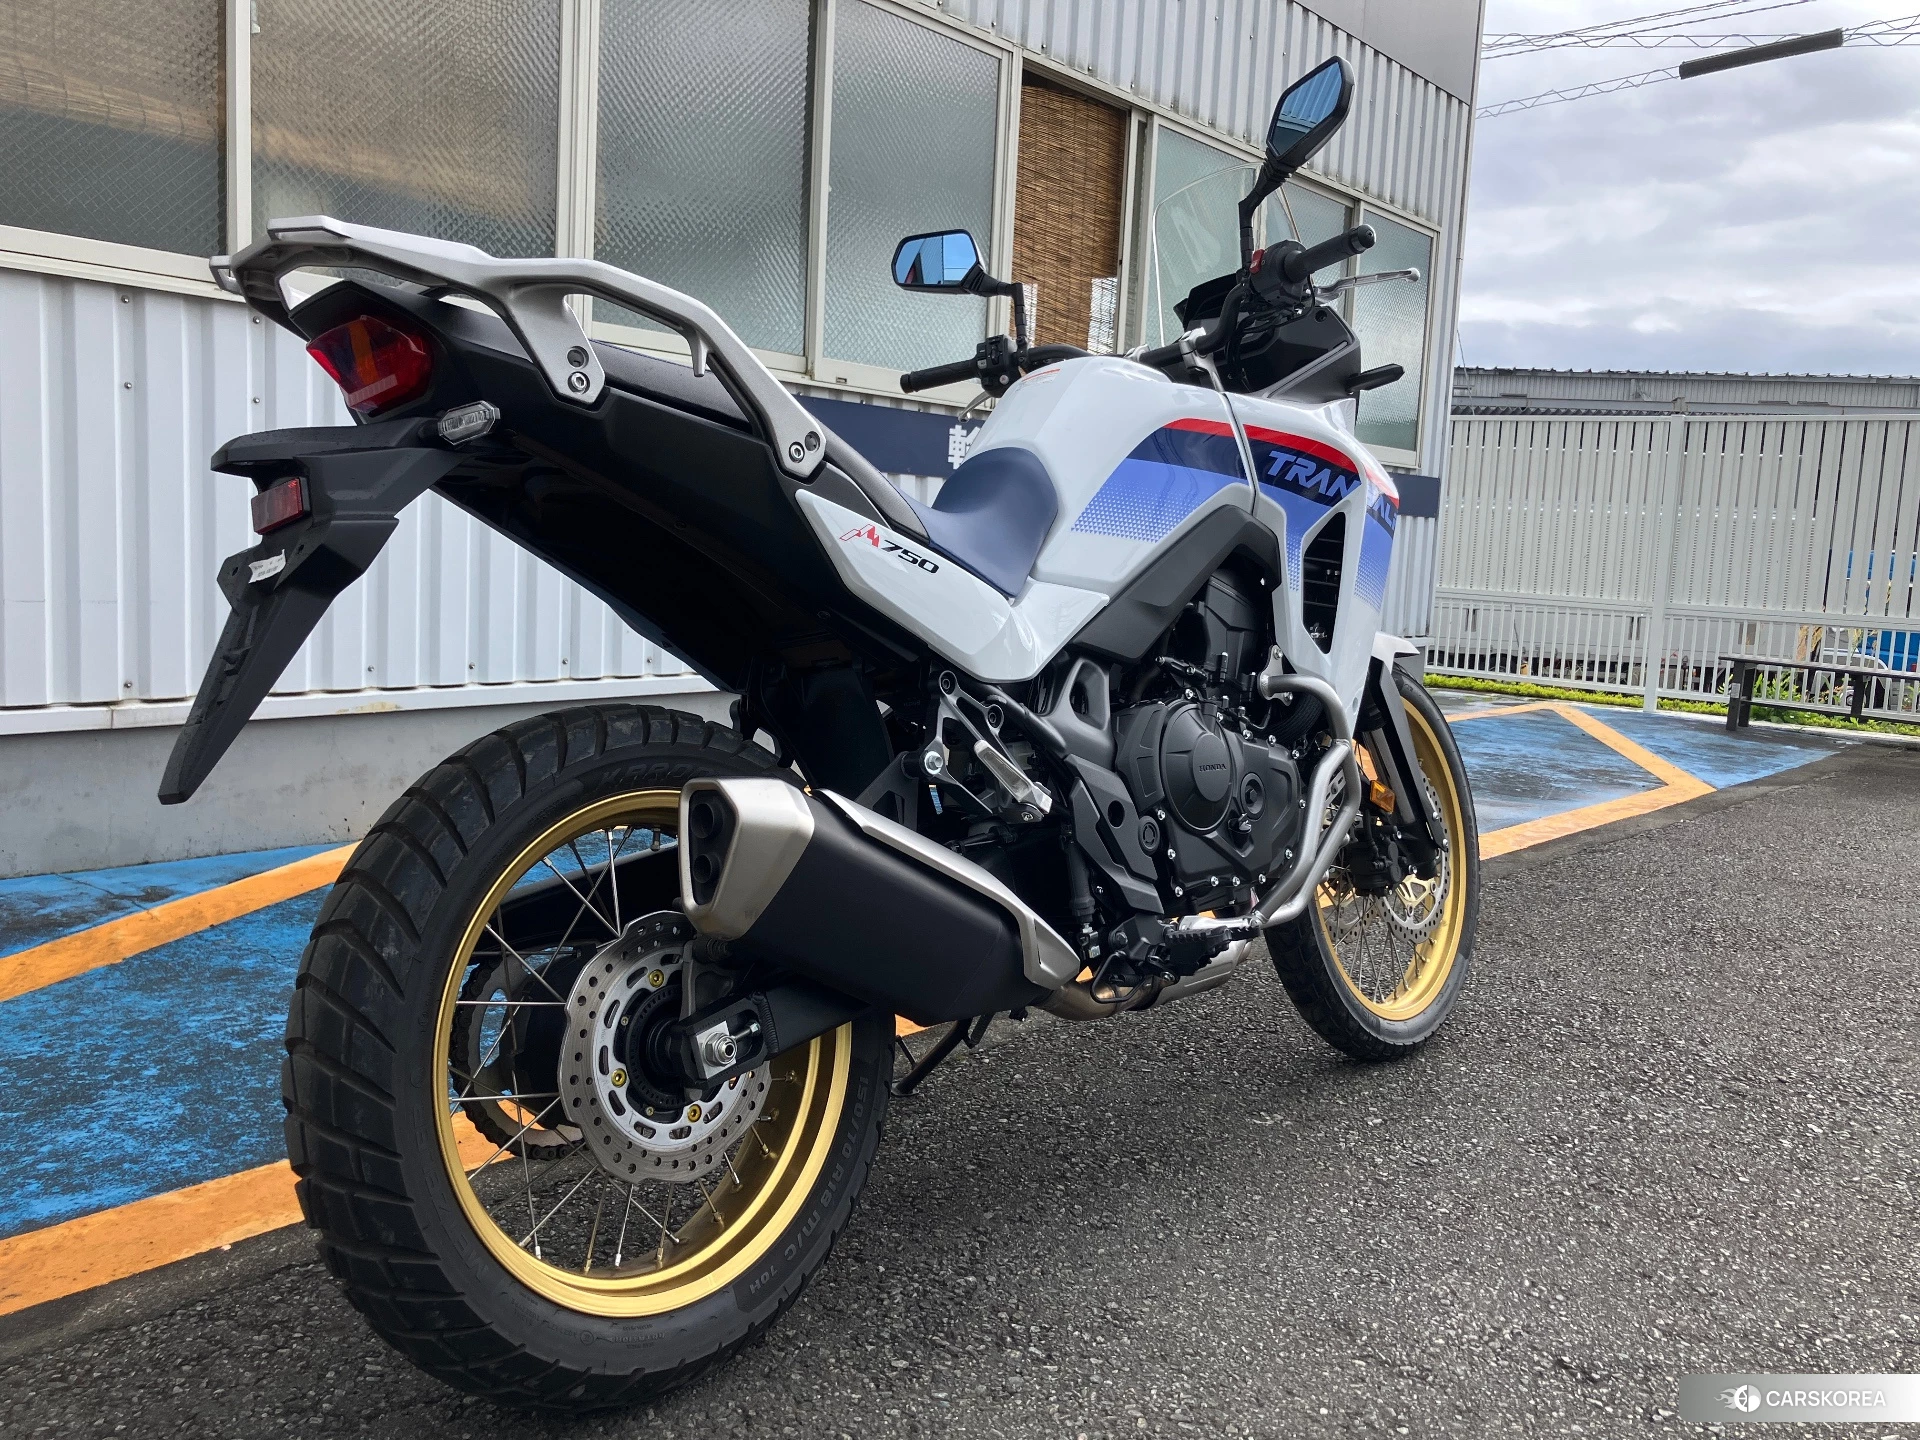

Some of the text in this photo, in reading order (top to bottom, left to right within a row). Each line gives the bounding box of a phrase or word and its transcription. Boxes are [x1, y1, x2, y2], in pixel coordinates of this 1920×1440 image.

[881, 539, 940, 574] 750
[1198, 763, 1227, 772] HONDA
[820, 1163, 844, 1208] R18
[783, 1210, 820, 1261] M/C
[748, 1264, 778, 1294] 70H
